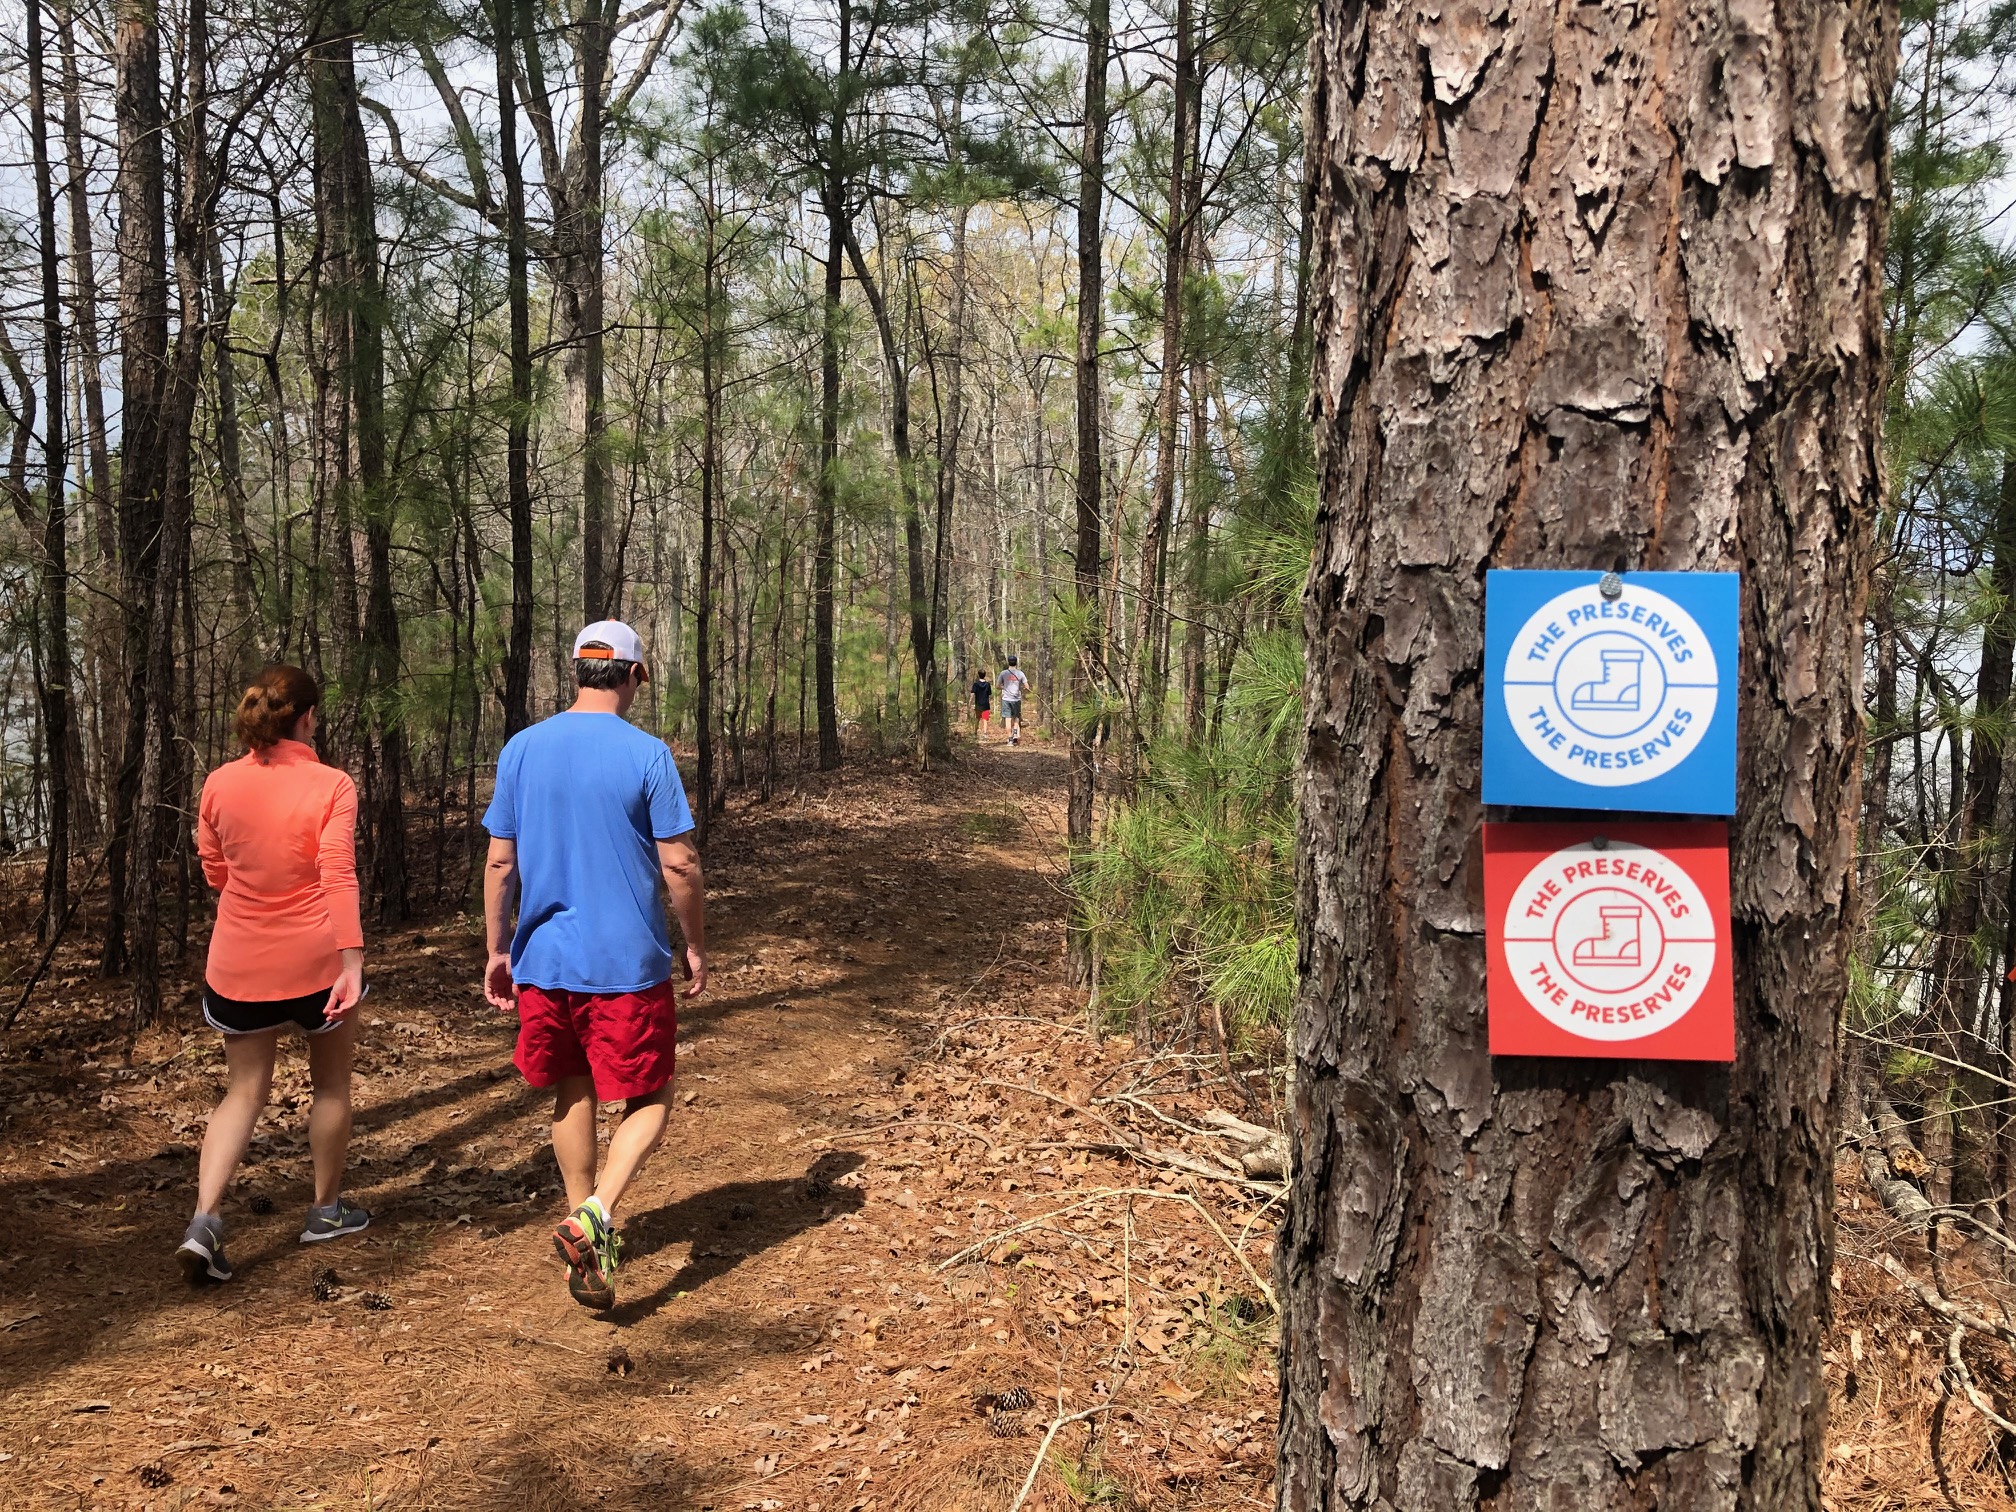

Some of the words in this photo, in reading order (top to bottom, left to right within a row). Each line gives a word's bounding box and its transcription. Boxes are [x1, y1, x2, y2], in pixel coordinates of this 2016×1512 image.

[1527, 622, 1566, 662] THE
[1567, 601, 1693, 664] PRESERVES
[1528, 705, 1567, 750] THE
[1567, 708, 1693, 769] PRESERVES
[1525, 879, 1562, 920] THE
[1562, 858, 1690, 919] PRESERVES
[1529, 961, 1569, 1006] THE
[1570, 962, 1692, 1024] PRESERVES
